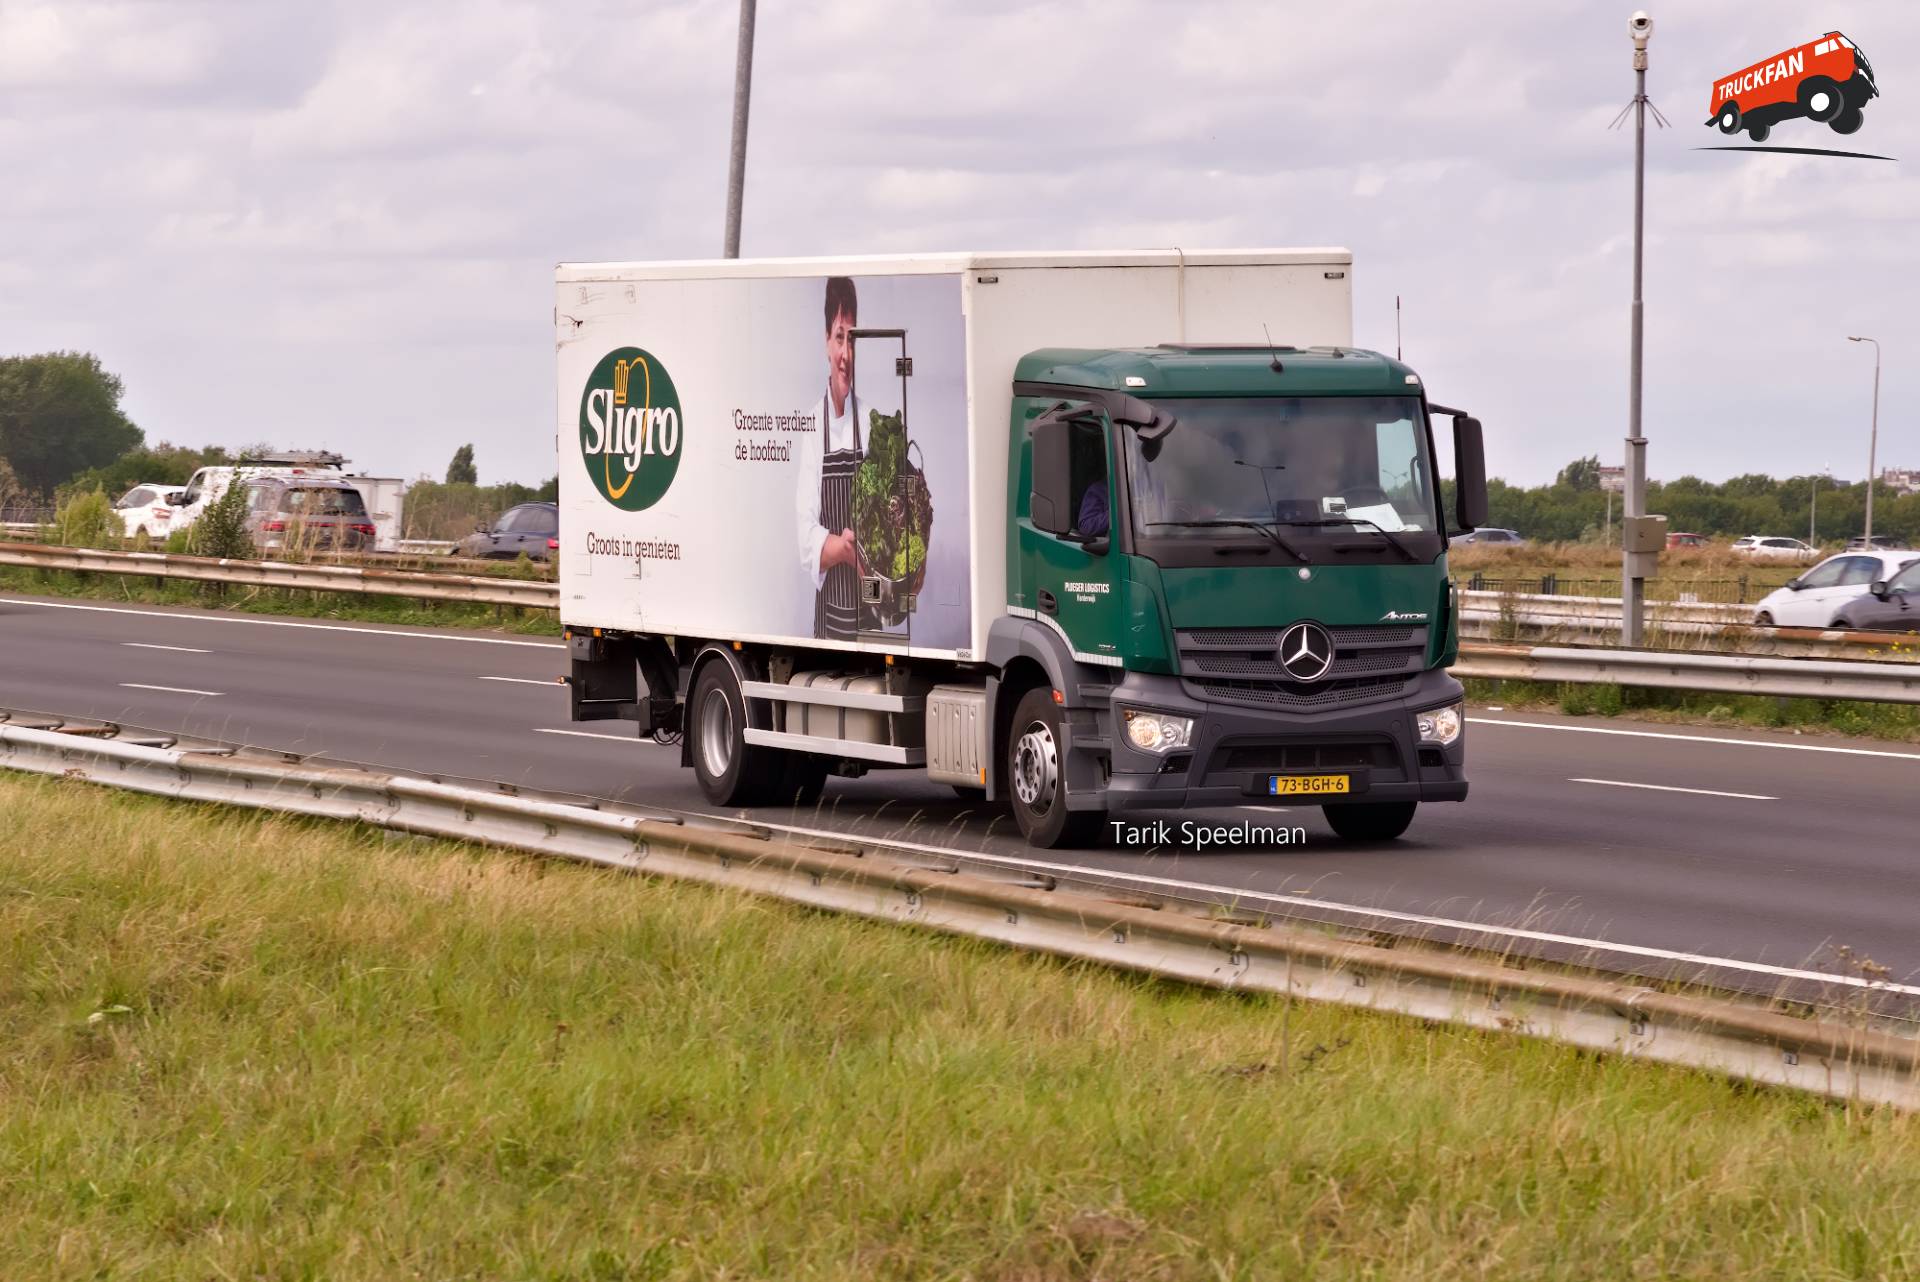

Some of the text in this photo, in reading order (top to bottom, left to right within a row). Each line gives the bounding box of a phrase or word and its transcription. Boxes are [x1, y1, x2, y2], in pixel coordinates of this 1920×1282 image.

[585, 388, 679, 473] Sligro
[775, 410, 816, 432] verdient
[735, 439, 748, 461] de
[586, 531, 681, 565] Groots in genieten
[1085, 583, 1110, 594] LOGISTICS
[1281, 778, 1344, 792] 73-BGH-6
